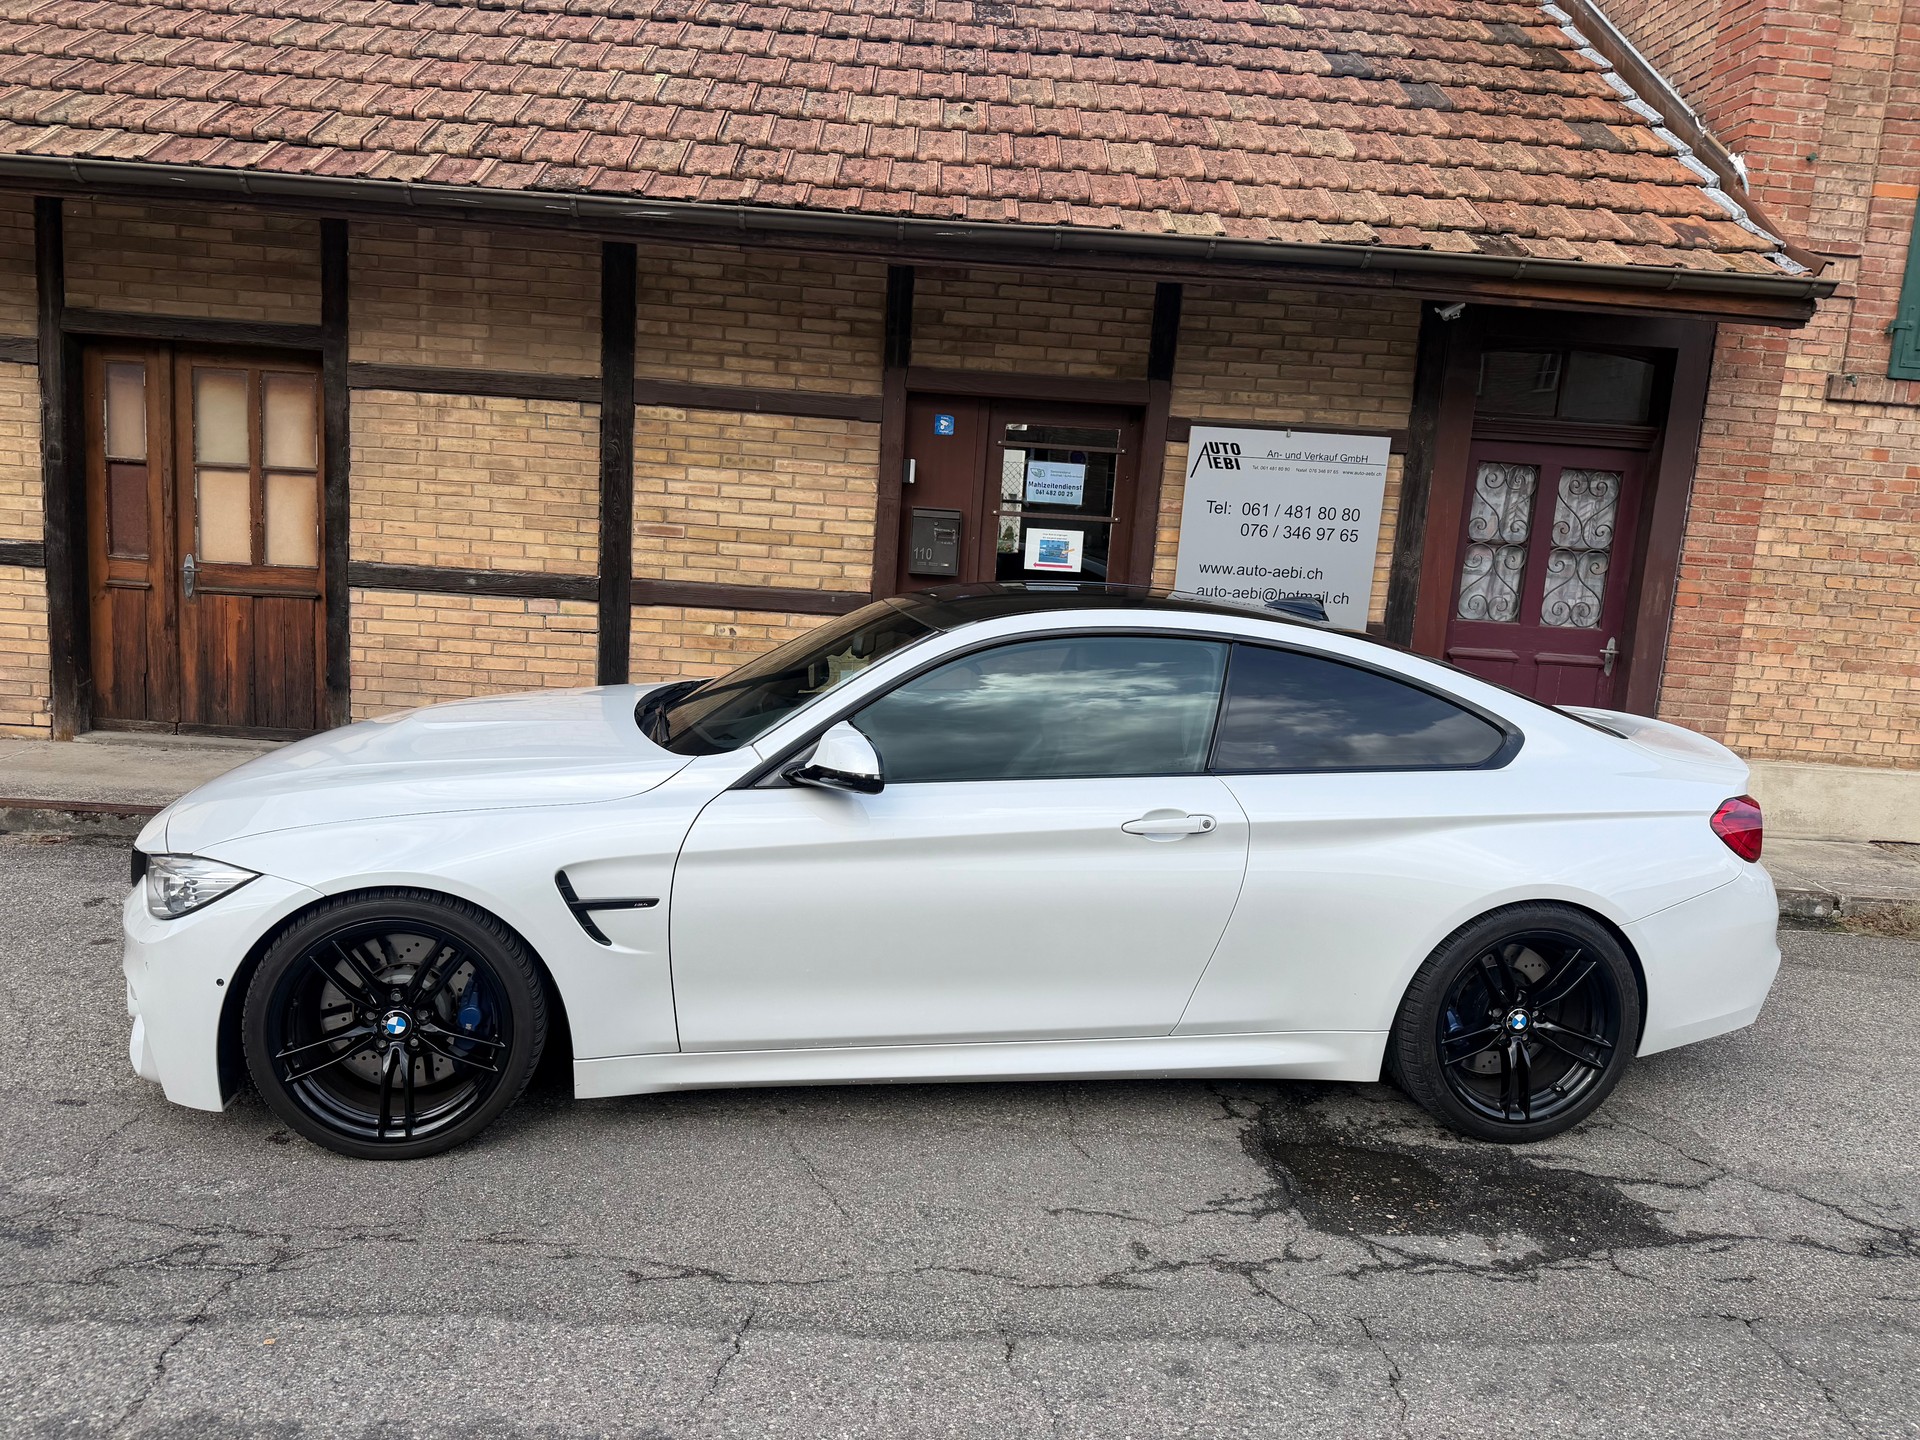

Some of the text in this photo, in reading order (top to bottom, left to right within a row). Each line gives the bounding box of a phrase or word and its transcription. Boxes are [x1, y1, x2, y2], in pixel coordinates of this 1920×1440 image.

[1266, 450, 1369, 463] An- und Verkauf GmbH
[1028, 480, 1083, 490] Mahlzeitendienst
[1206, 500, 1361, 522] Tel: 061 / 481 80 80
[1240, 523, 1359, 543] 076 / 346 97 65
[914, 547, 932, 560] 110
[1199, 563, 1323, 580] www.auto-aebi.ch
